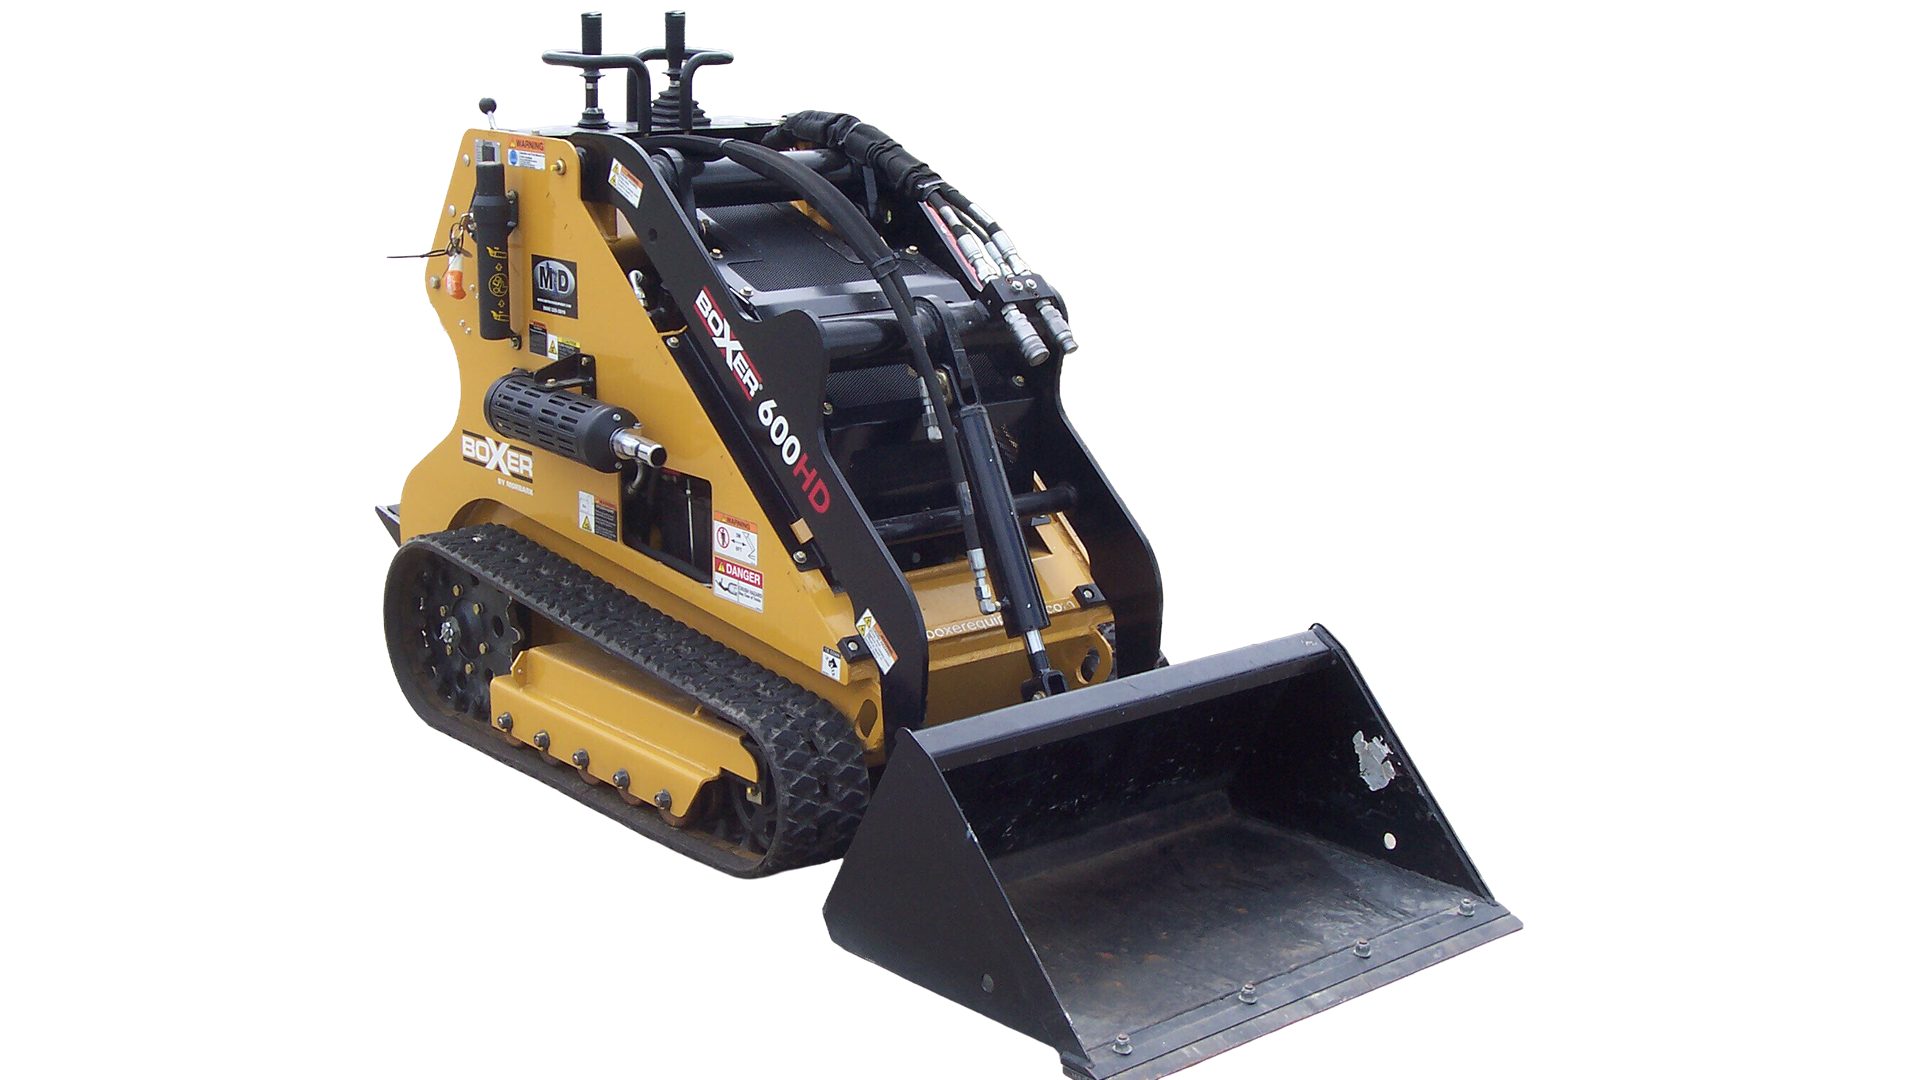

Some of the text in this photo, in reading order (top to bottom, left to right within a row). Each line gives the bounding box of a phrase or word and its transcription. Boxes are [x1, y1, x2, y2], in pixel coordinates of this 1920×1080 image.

[516, 139, 544, 151] WARNING
[695, 290, 762, 397] BOXER
[462, 435, 533, 477] BOXER
[727, 516, 751, 531] WARNING
[725, 563, 761, 586] DANGER
